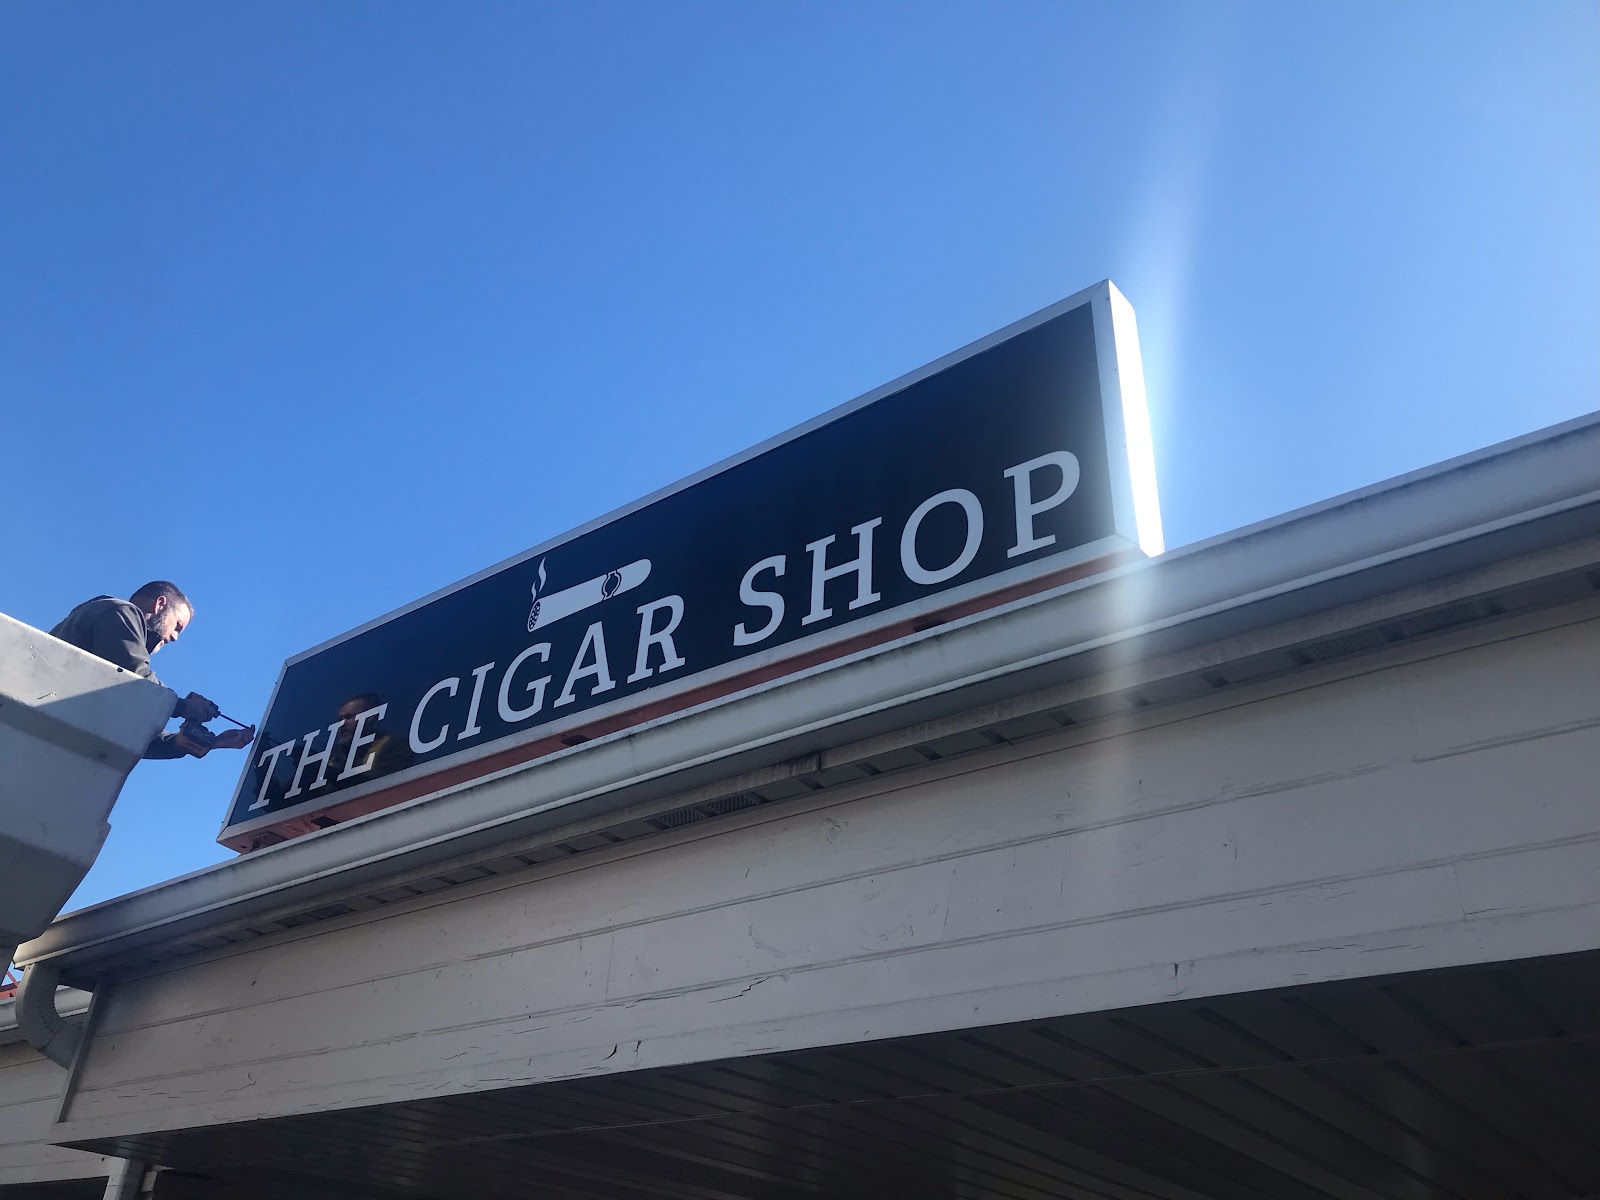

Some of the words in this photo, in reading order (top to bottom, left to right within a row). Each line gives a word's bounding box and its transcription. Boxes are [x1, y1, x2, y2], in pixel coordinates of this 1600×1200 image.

[248, 702, 389, 811] THE
[408, 594, 686, 754] CIGAR
[733, 450, 1081, 647] SHOP
